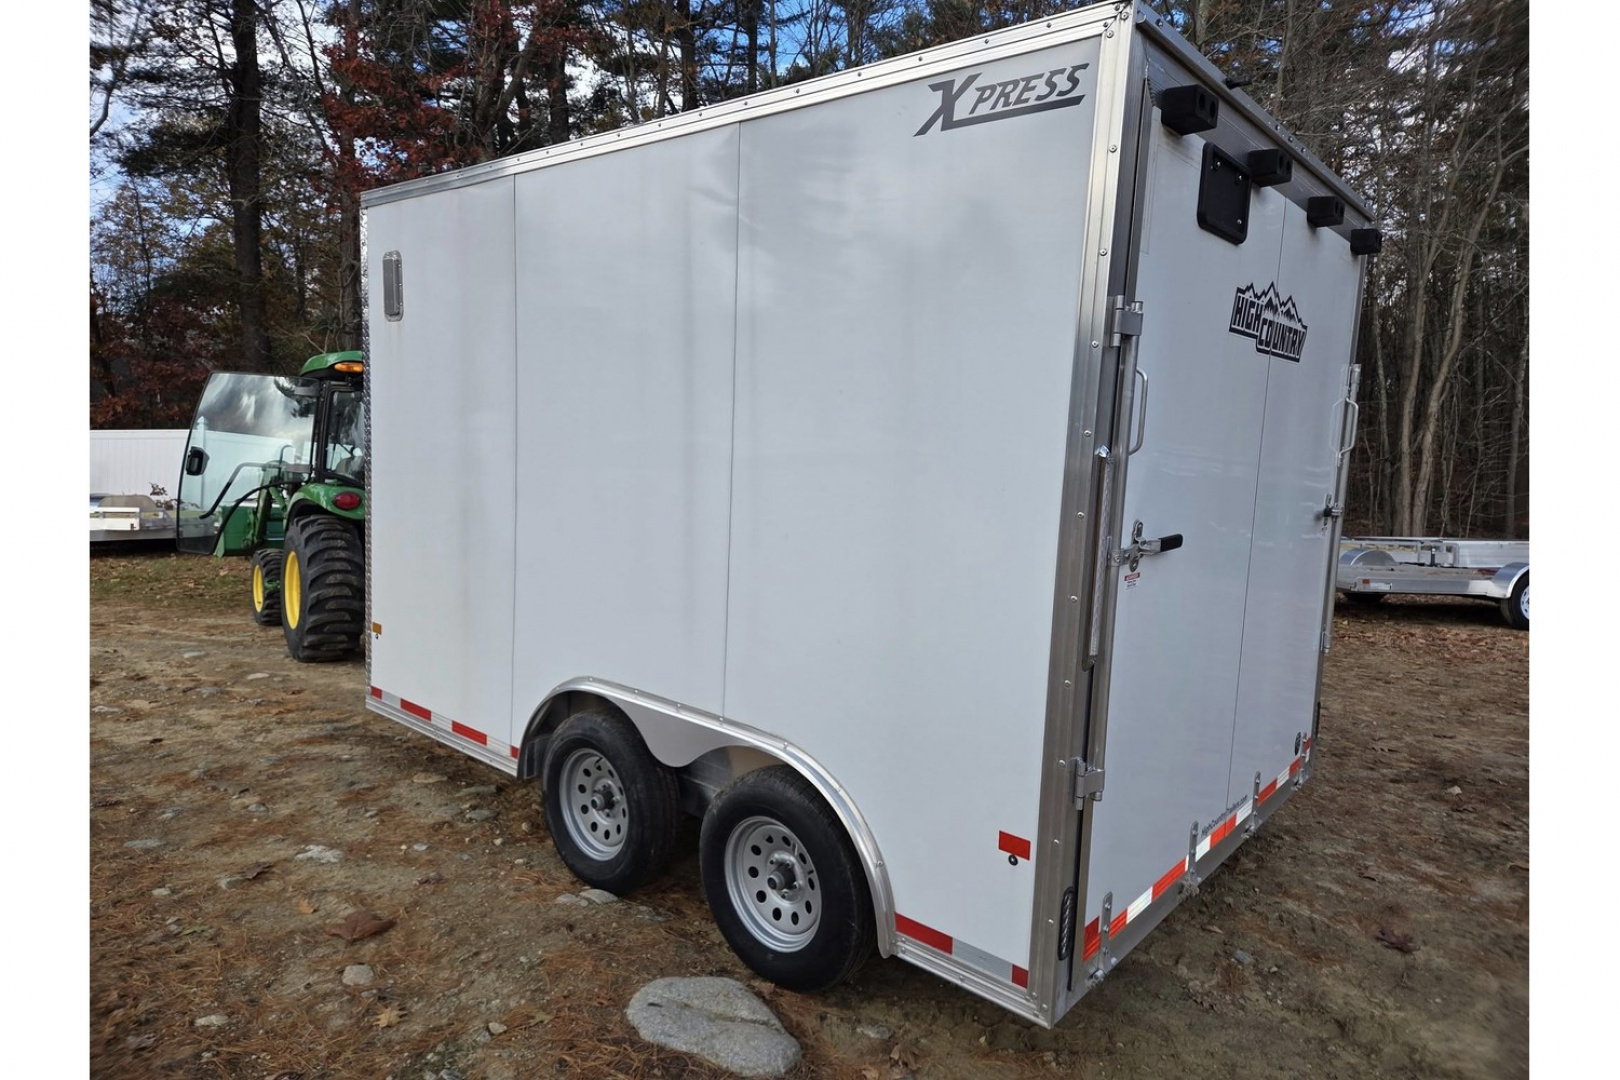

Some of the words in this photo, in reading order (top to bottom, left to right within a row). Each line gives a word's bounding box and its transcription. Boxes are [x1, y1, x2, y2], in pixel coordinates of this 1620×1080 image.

[913, 63, 1090, 137] XPRESS
[1232, 295, 1263, 333] HIGH
[1257, 317, 1306, 358] COUNTRY
